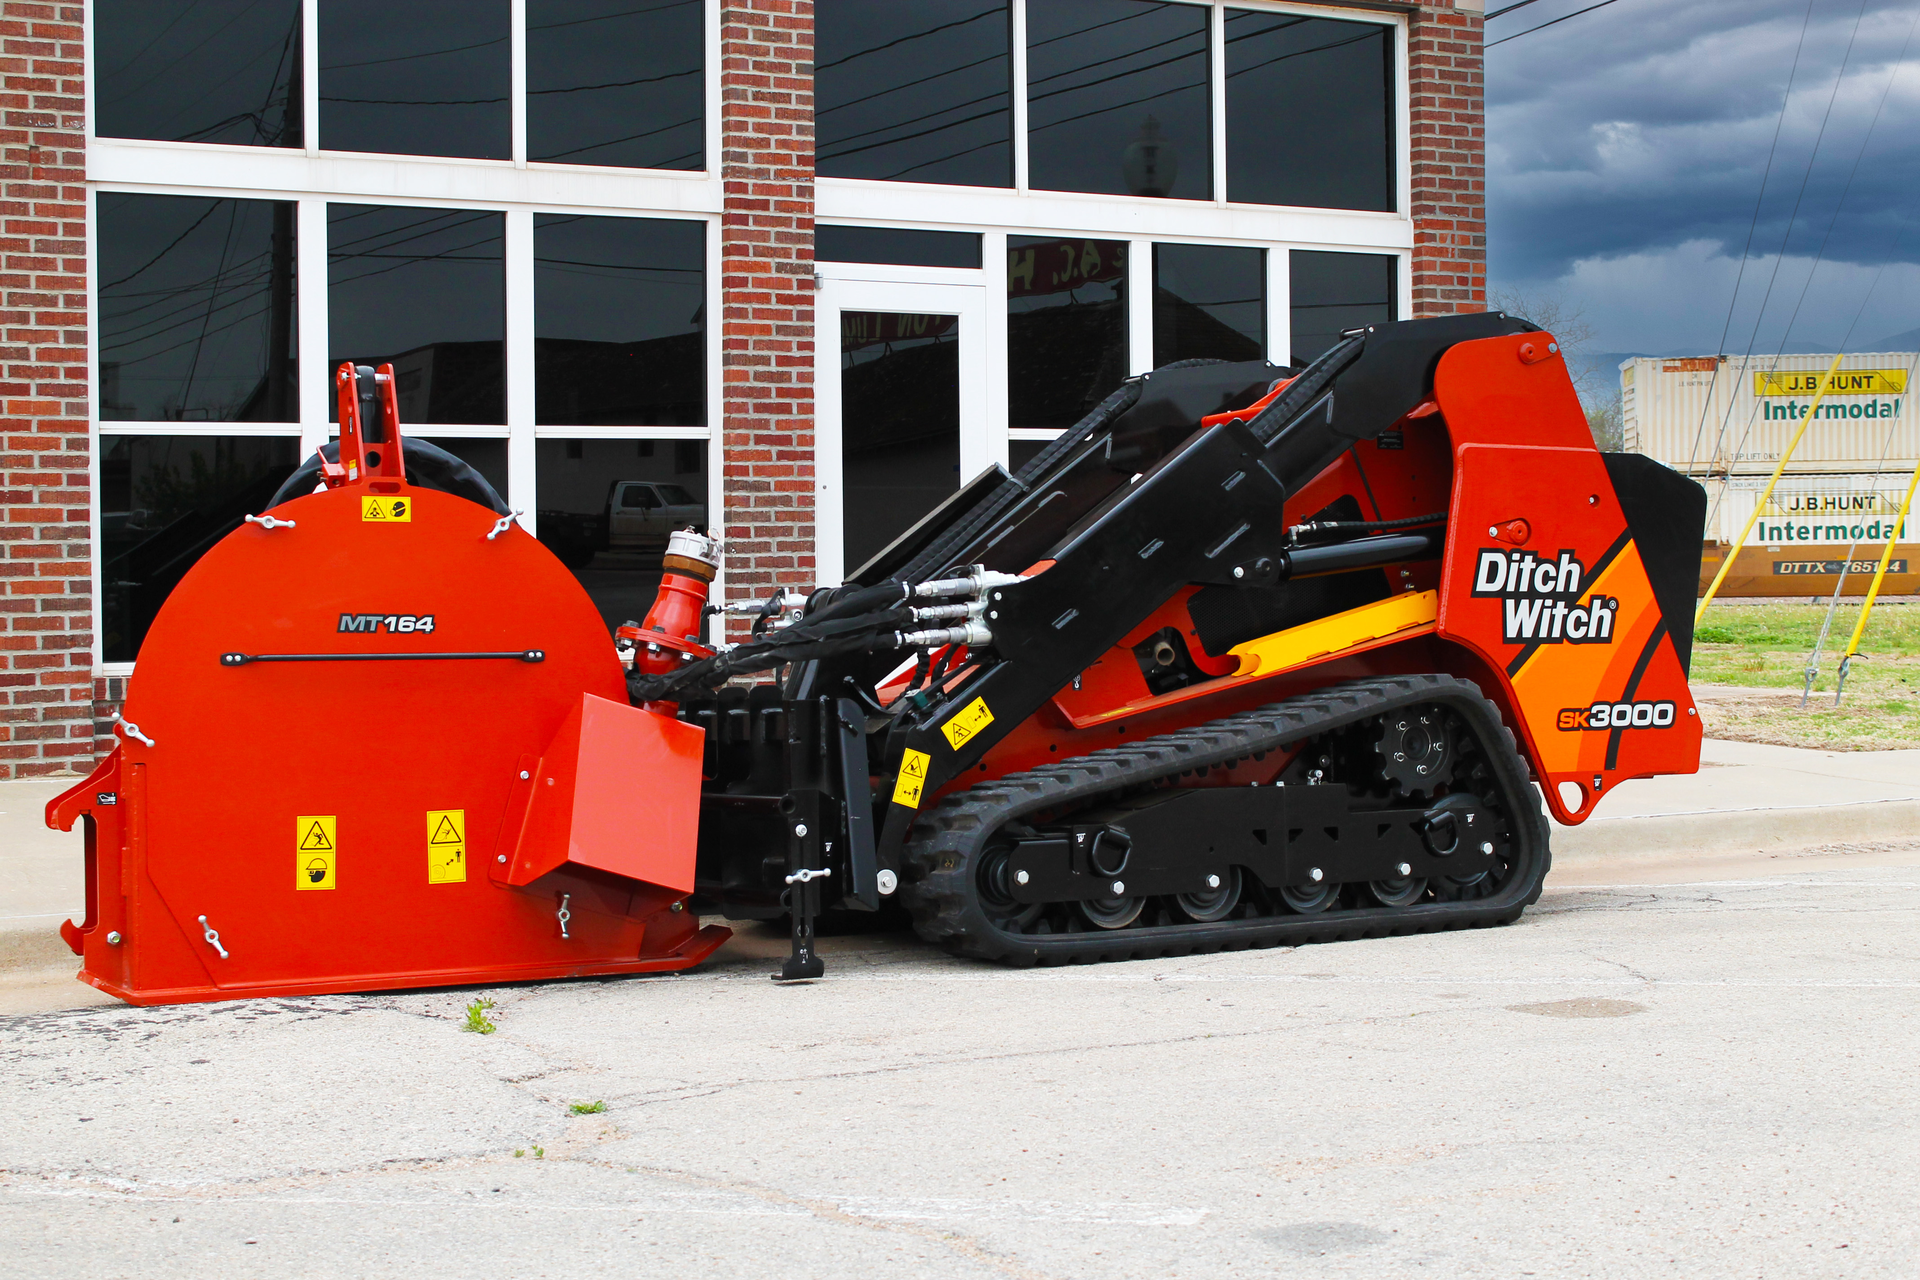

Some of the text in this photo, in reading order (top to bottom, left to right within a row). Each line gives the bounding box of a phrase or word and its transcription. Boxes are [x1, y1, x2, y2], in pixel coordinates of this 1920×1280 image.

[1764, 398, 1900, 420] Intermodal
[1759, 520, 1906, 541] Intermodal
[1475, 553, 1581, 593] Ditch
[1780, 562, 1826, 574] DTTX
[339, 615, 434, 633] MT164
[1558, 703, 1675, 729] SK3000
